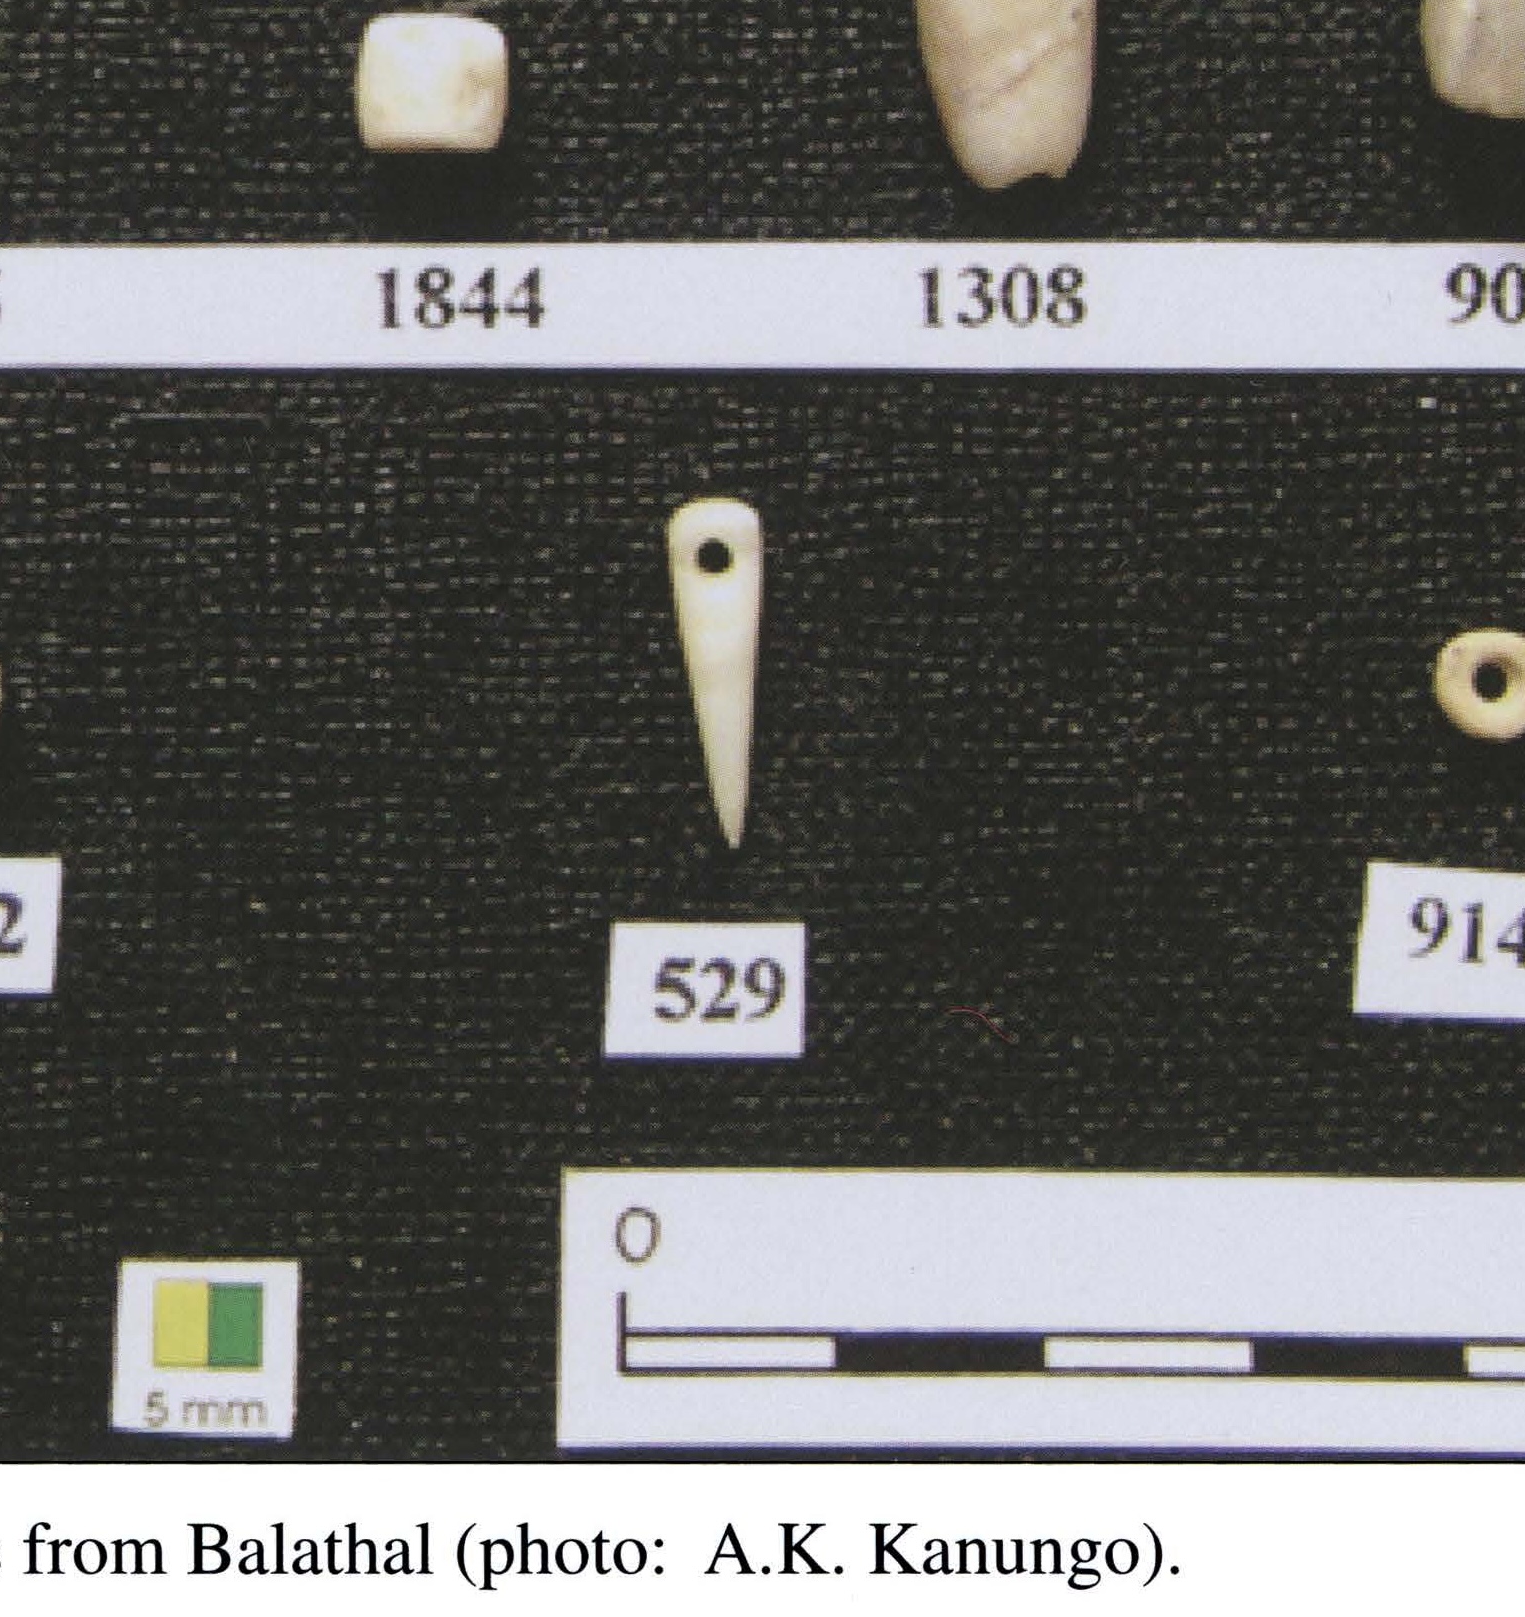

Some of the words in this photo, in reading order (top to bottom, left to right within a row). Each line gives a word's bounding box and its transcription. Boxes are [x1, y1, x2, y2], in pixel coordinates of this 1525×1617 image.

[378, 265, 547, 331] 1844
[920, 265, 1086, 329] 1308
[653, 955, 788, 1023] 529
[143, 1388, 171, 1428] 5
[182, 1396, 269, 1428] mm
